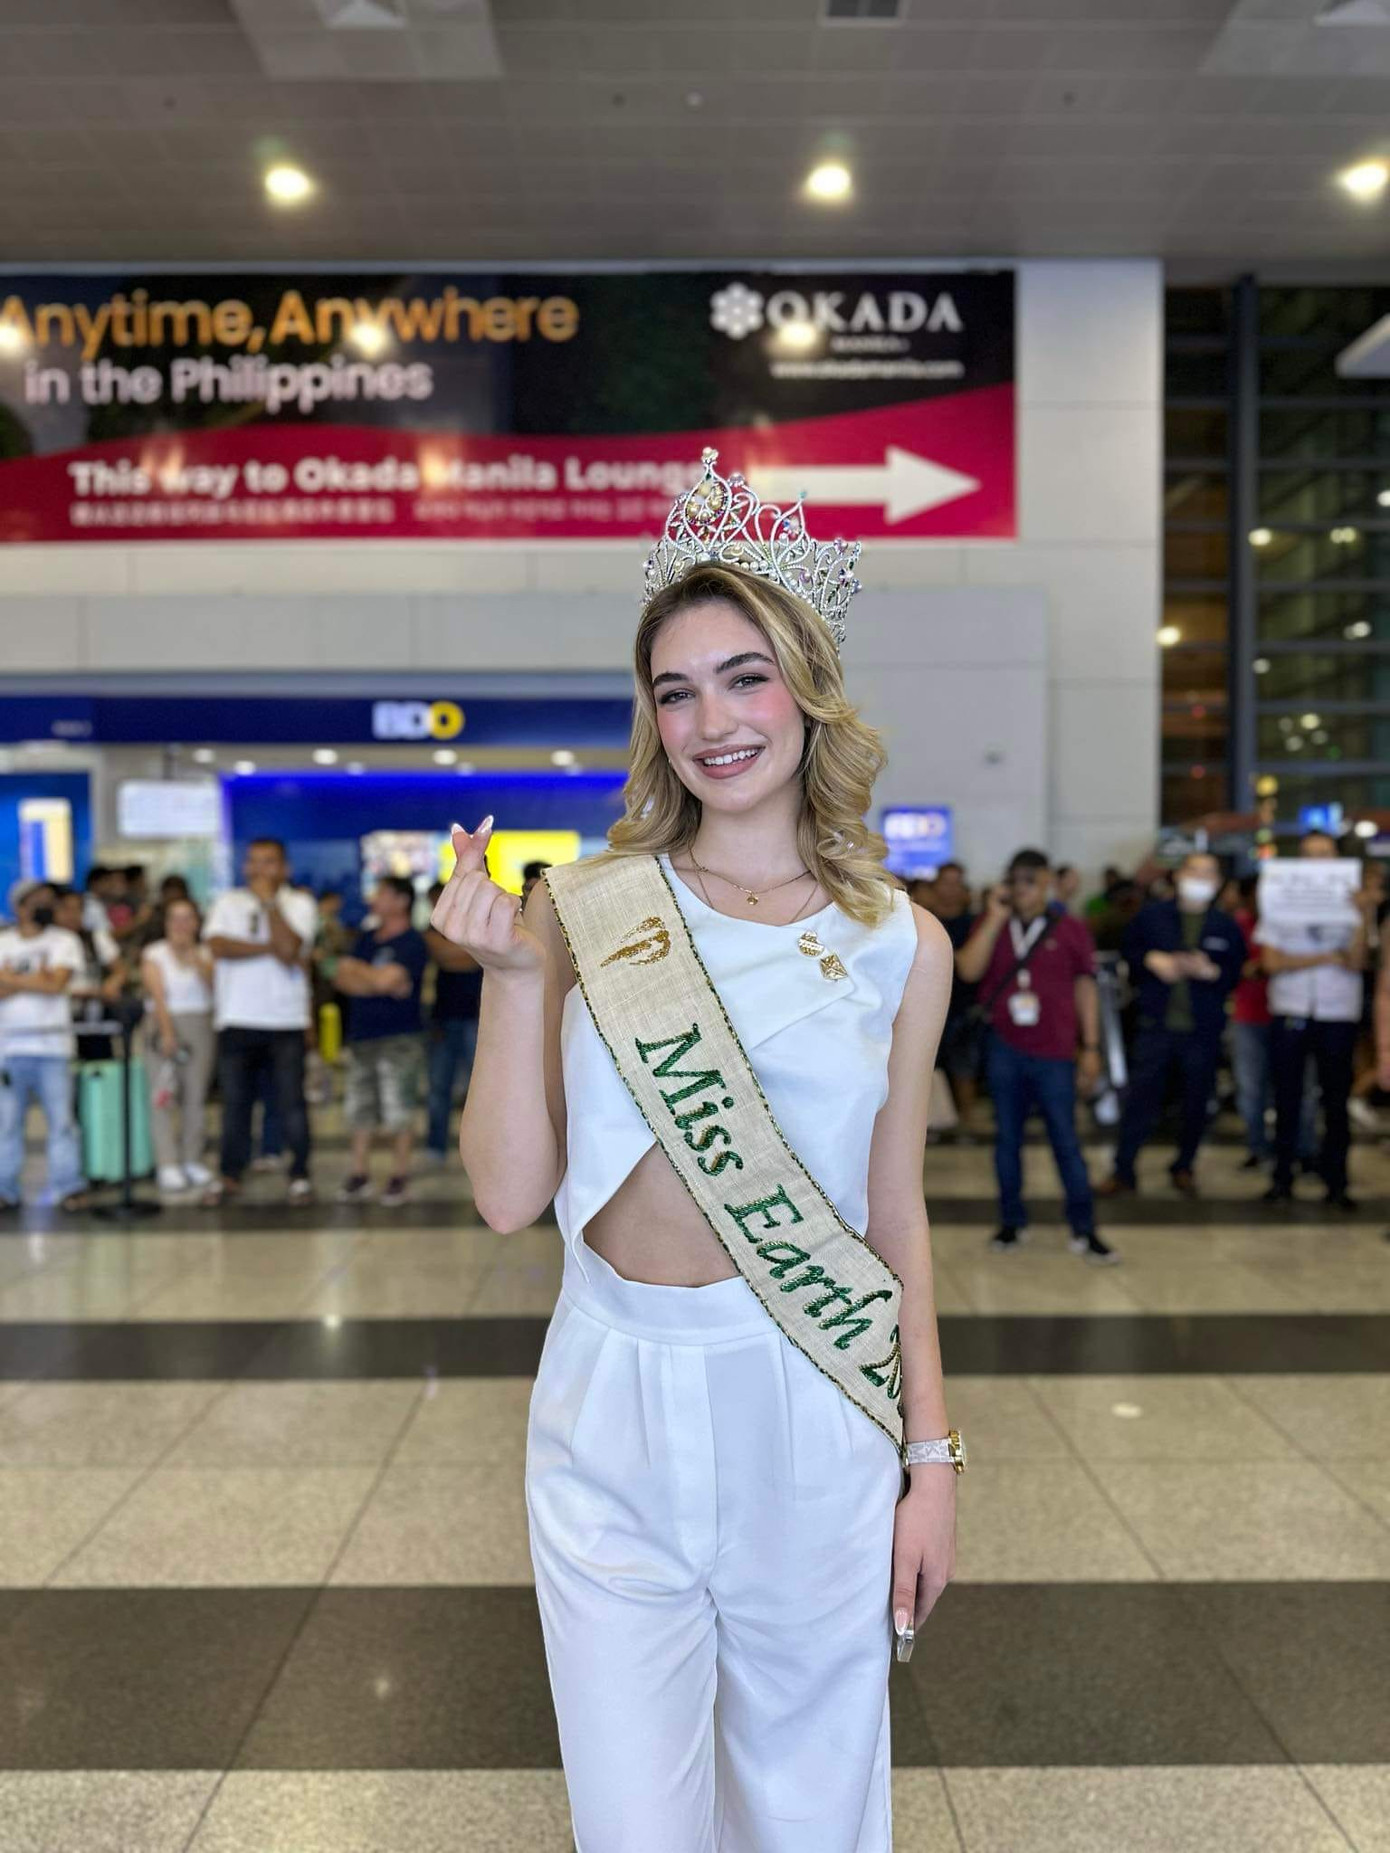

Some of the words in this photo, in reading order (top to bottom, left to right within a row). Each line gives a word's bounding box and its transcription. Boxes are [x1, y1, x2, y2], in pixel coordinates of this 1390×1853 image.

[0, 290, 265, 359] Anytime,
[269, 288, 579, 351] Anywhere
[766, 291, 963, 333] OKADA
[25, 358, 70, 404] in
[80, 358, 163, 404] the
[171, 354, 434, 413] Philippines
[67, 459, 151, 496] This
[243, 459, 290, 494] to
[293, 456, 418, 493] Okada
[634, 1022, 744, 1176] Miss
[724, 1183, 893, 1350] Earth
